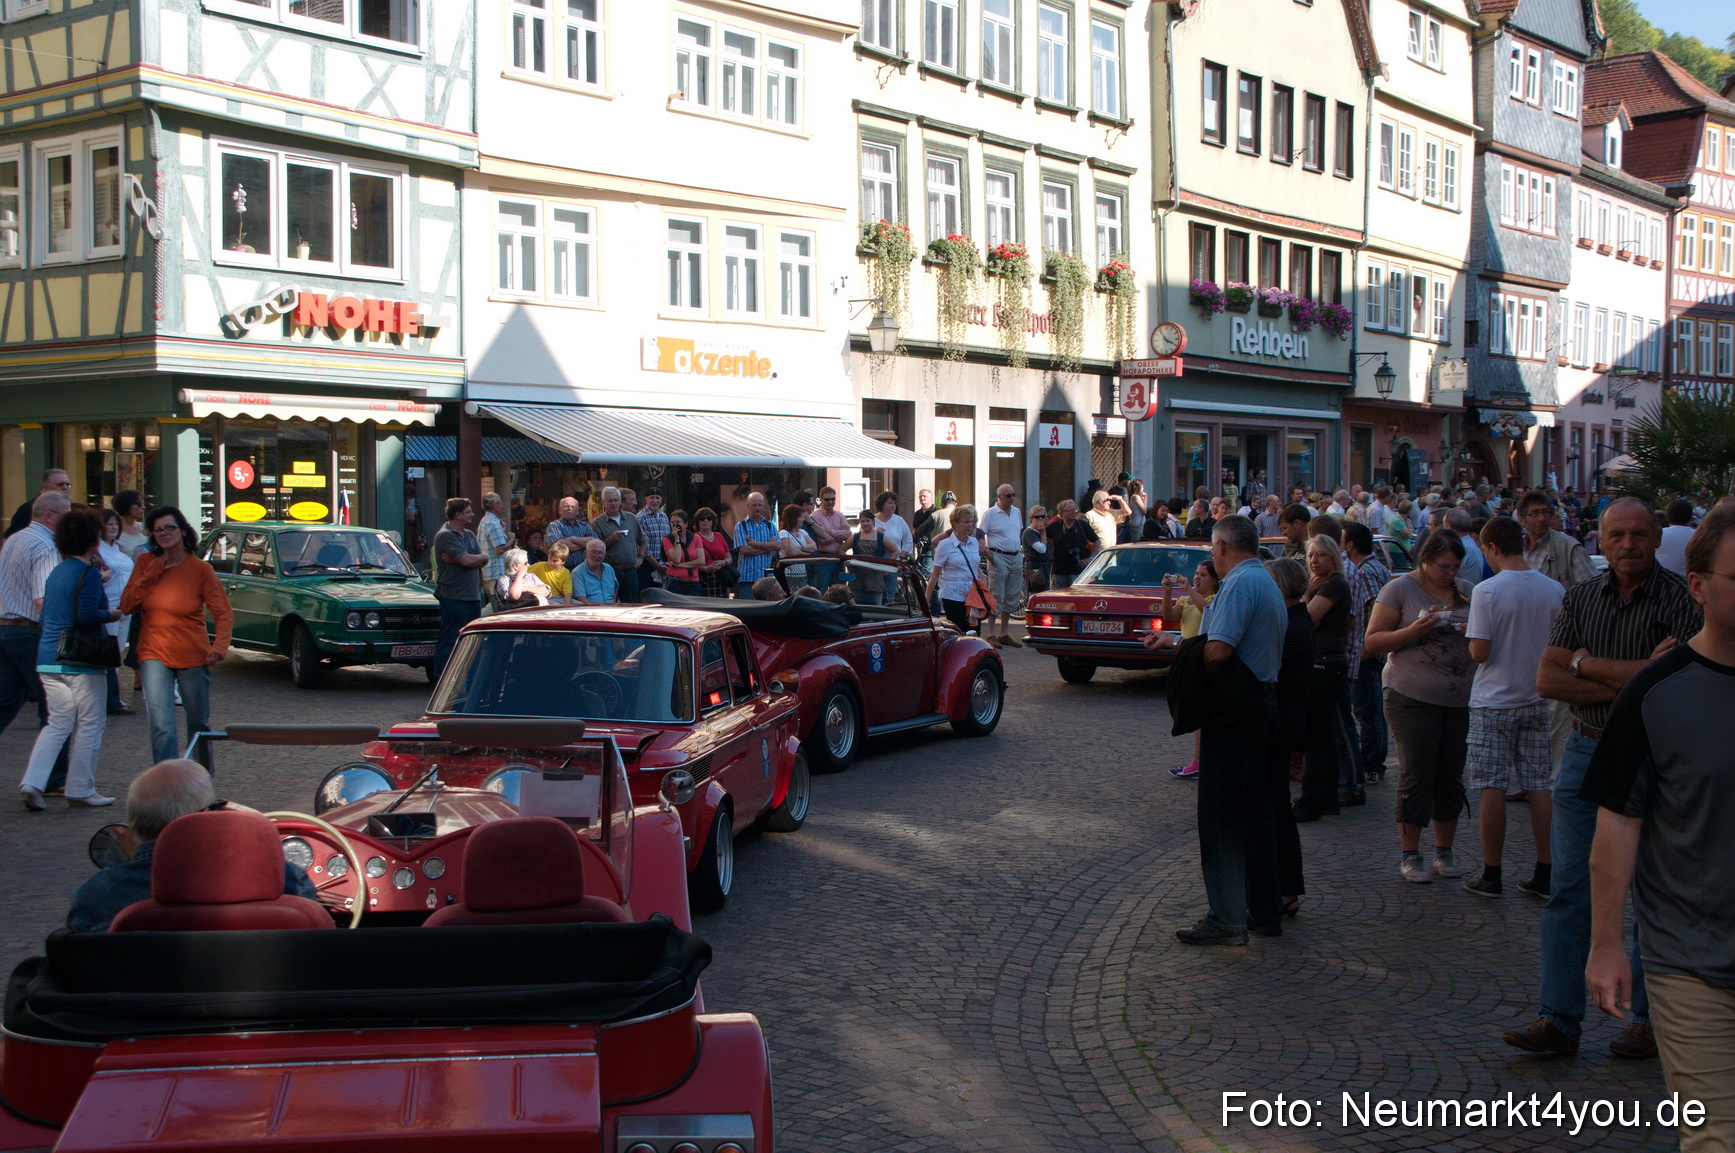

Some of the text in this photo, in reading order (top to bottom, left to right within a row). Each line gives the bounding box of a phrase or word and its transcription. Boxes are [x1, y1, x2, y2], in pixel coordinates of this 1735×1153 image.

[297, 291, 418, 334] NOHE
[1230, 316, 1309, 359] Rehbein
[1123, 367, 1173, 375] HOFAPOTHEKE
[205, 393, 271, 405] Optik NOHE
[369, 402, 426, 412] Optik NOHE
[1083, 622, 1121, 632] WÜ 0734
